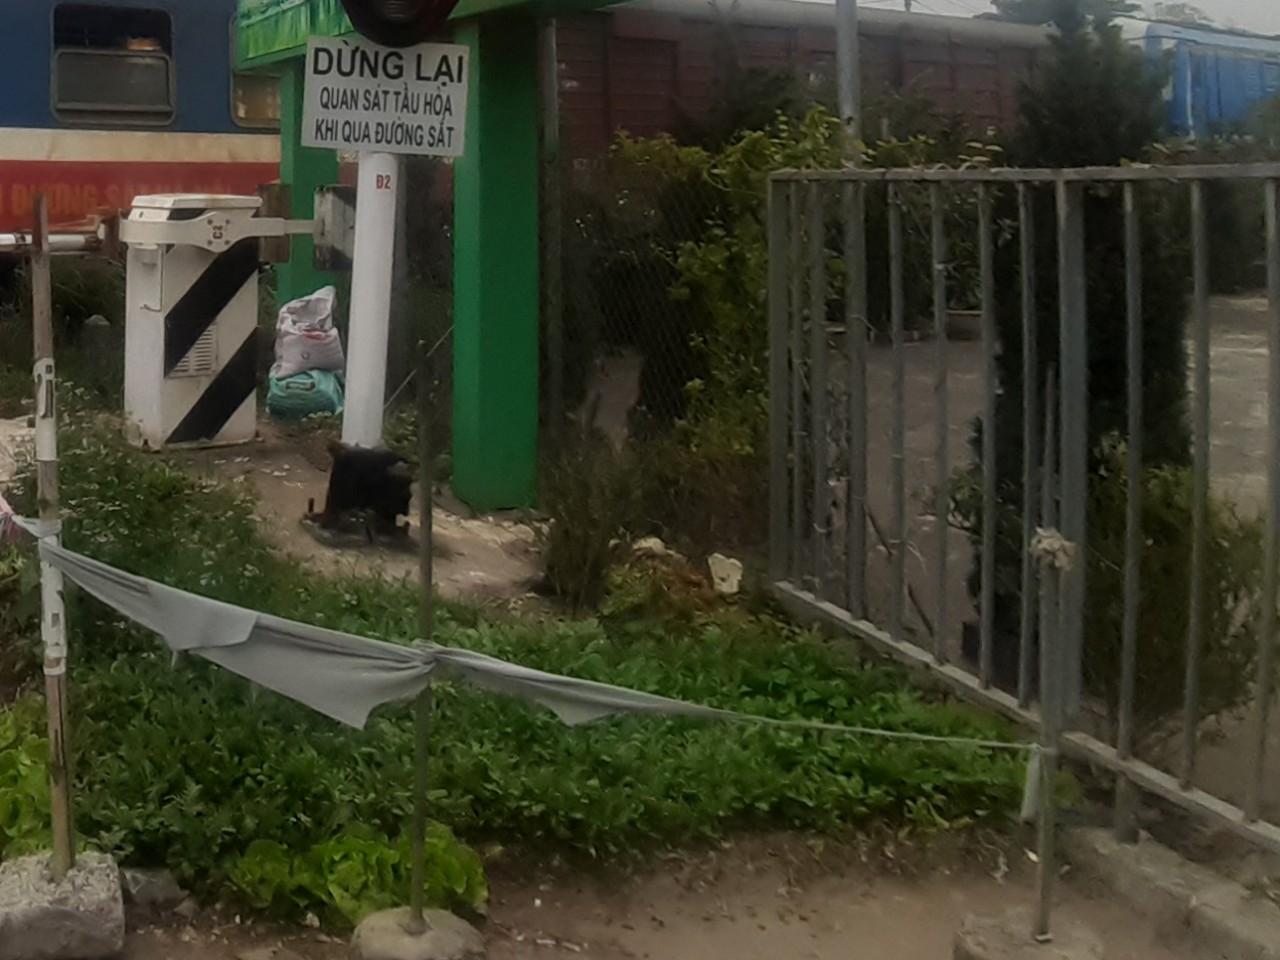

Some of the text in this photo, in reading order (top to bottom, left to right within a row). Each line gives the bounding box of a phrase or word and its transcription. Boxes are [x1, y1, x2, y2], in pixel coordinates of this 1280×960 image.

[312, 40, 464, 87] DỪNG LẠI
[320, 86, 359, 111] QUAN
[362, 83, 390, 112] SÁT
[423, 86, 453, 116] HỎA
[314, 115, 455, 148] KHI QUA ĐƯỜNG SẮT
[212, 225, 224, 240] C2
